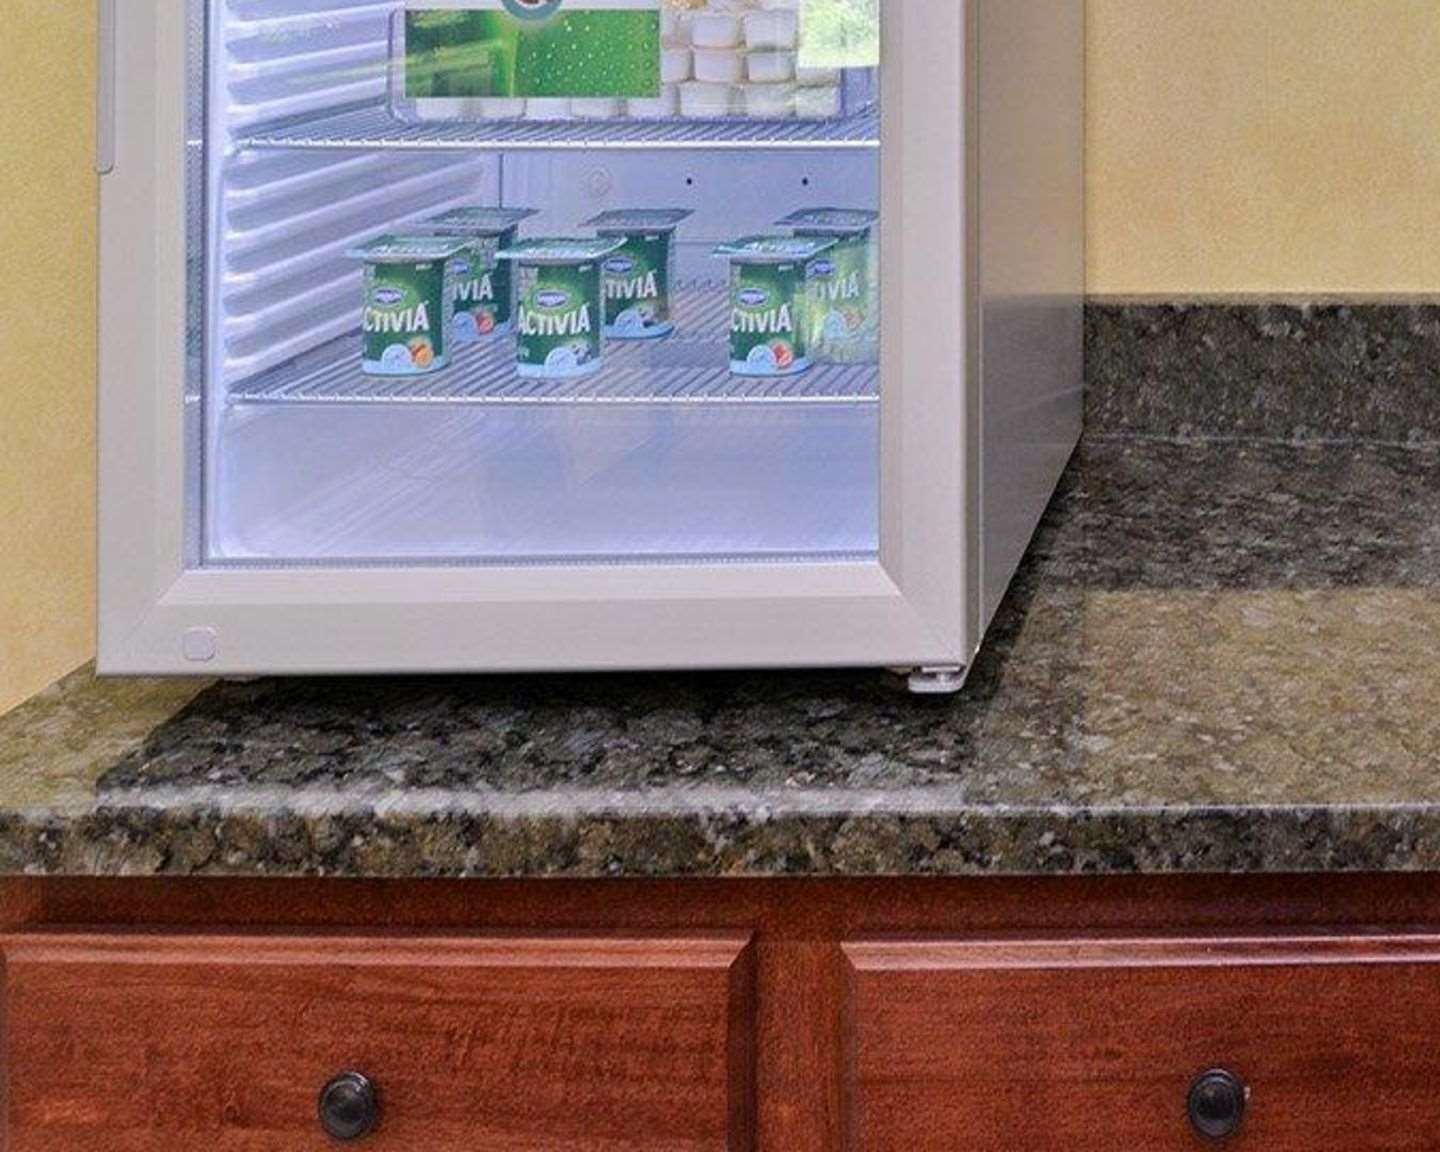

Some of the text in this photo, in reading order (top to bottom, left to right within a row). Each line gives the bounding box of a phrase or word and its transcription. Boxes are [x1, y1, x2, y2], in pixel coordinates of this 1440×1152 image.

[605, 270, 658, 299] TIVIA
[362, 301, 430, 333] CTIVIA
[730, 303, 793, 333] CTIVIA
